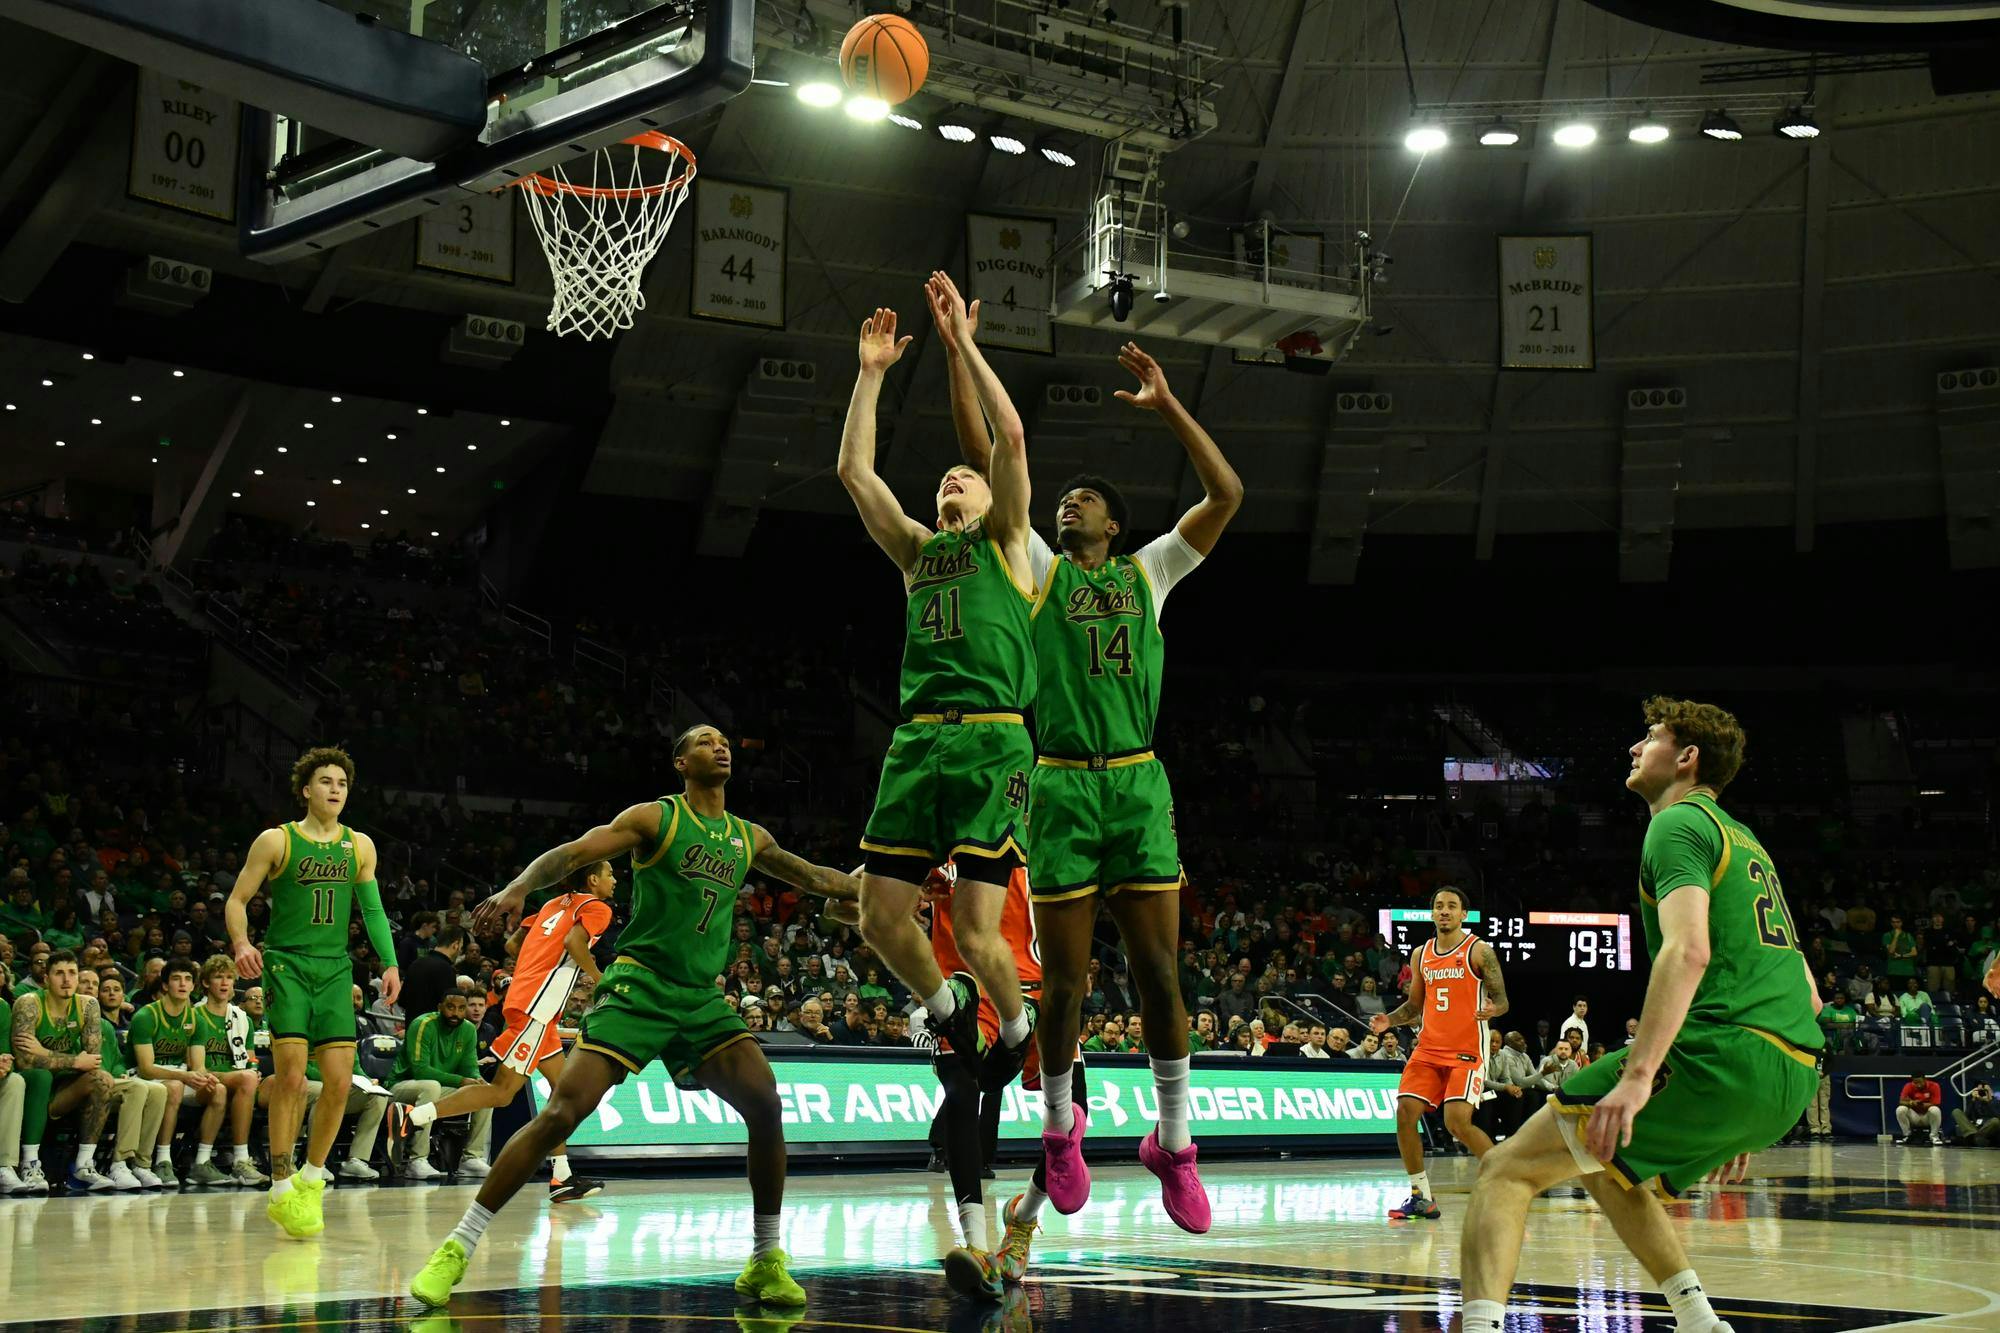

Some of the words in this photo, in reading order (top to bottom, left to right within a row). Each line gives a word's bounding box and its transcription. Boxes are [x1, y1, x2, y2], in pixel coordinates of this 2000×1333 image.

[162, 99, 217, 125] RILEY
[165, 131, 205, 169] 00
[151, 173, 178, 190] 1997
[189, 184, 215, 200] 2001
[458, 205, 473, 234] 3
[721, 254, 755, 285] 44
[976, 258, 1045, 280] DIGGINS
[710, 294, 734, 306] 2006
[744, 298, 767, 311] 2010
[1002, 285, 1017, 312] 4
[1508, 279, 1584, 297] McBRIDE
[1529, 304, 1562, 333] 21
[1519, 343, 1543, 354] 2010
[1552, 344, 1576, 354] 2014
[919, 586, 964, 643] 41
[1066, 581, 1144, 620] Irish
[1086, 625, 1134, 677] 14
[295, 855, 350, 885] Irish
[680, 843, 737, 888] Irish
[310, 887, 336, 926] 11
[695, 887, 719, 935] 7
[540, 908, 567, 938] 4
[1488, 917, 1524, 938] 3:13
[1569, 930, 1598, 969] 19
[1605, 935, 1612, 947] 3
[1423, 967, 1466, 986] Syracuse
[1606, 954, 1616, 970] 6
[1435, 987, 1450, 1012] 5
[1133, 1087, 1269, 1121] UDER
